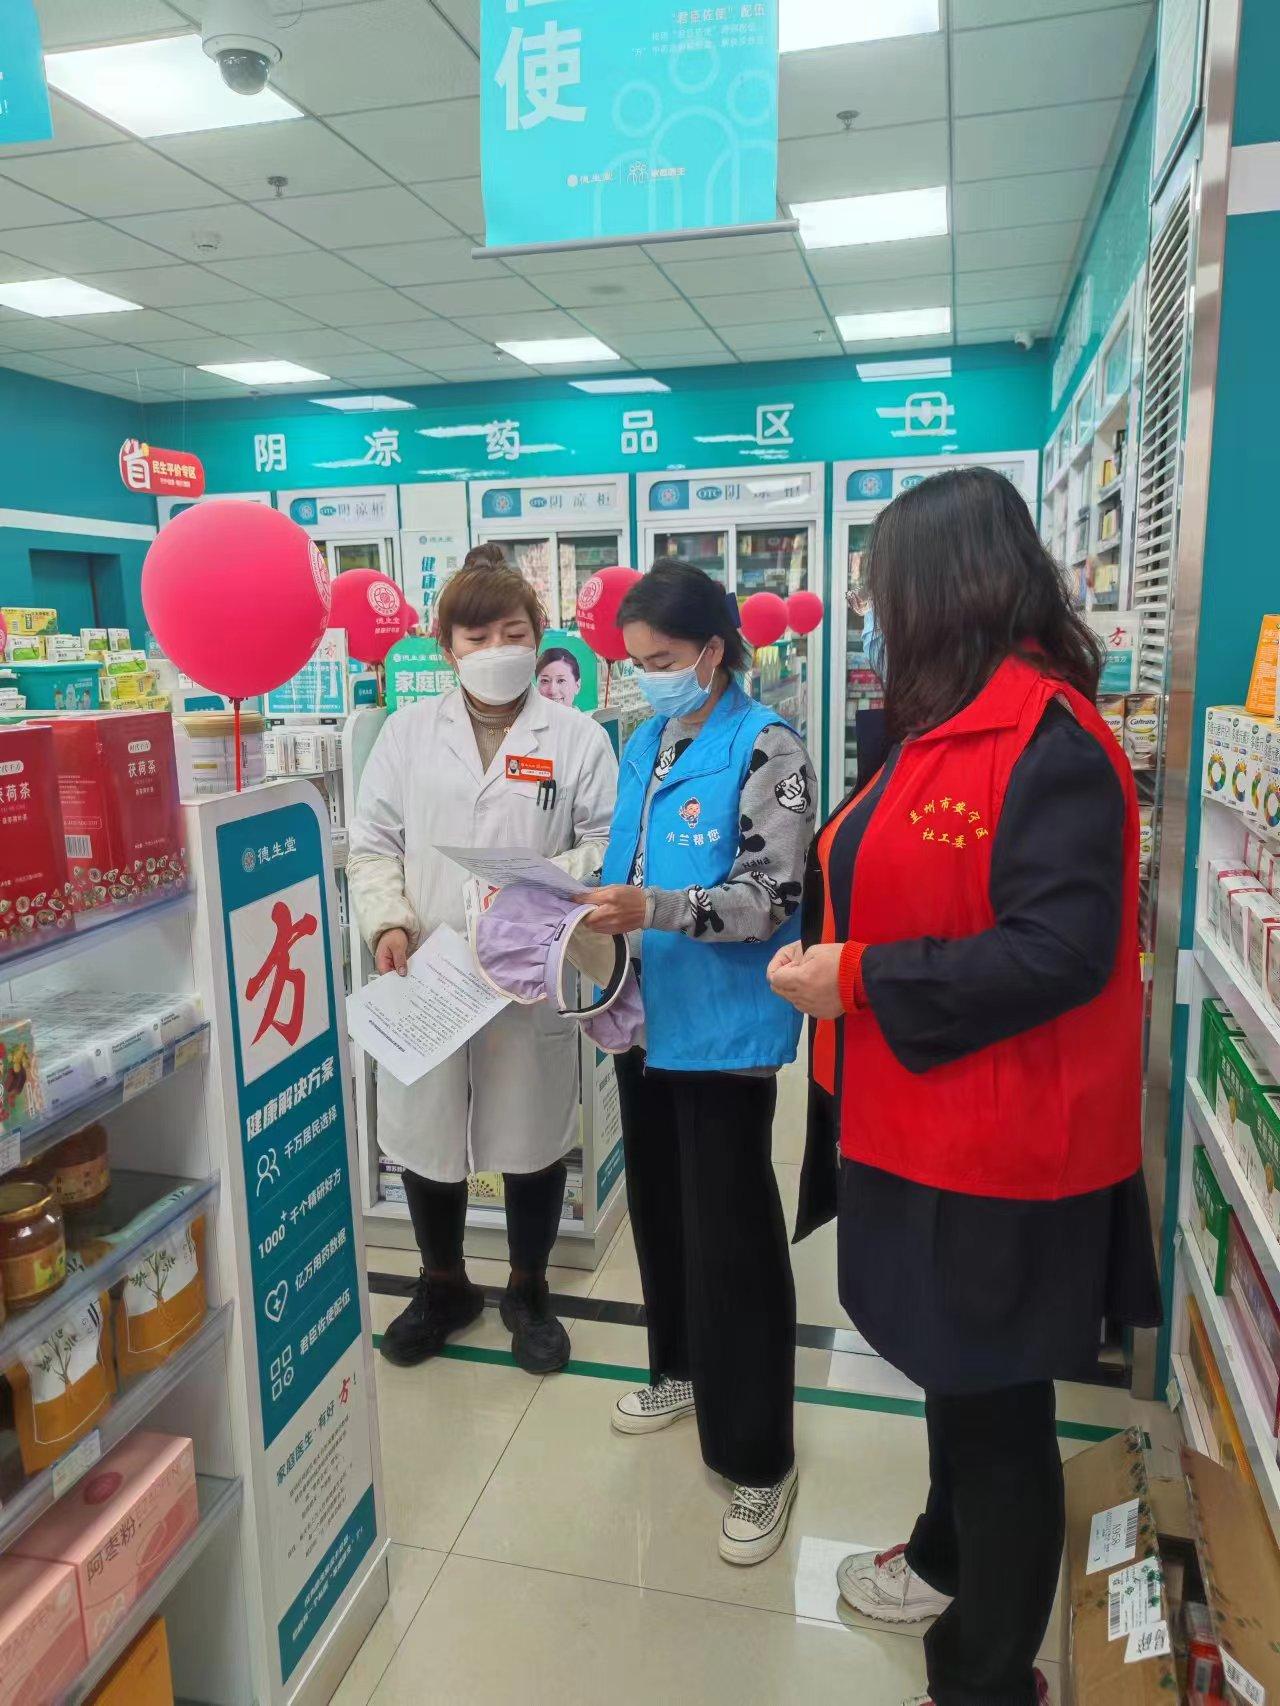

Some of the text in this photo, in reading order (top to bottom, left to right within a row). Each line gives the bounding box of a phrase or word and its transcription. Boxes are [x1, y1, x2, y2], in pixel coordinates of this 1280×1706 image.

[122, 438, 152, 490] 省
[253, 403, 795, 473] 阴凉药品区
[697, 486, 721, 499] OTC
[1108, 626, 1127, 647] 方
[1129, 718, 1156, 727] Caltrate
[257, 837, 297, 864] 德生堂
[665, 828, 721, 847] 小兰帮您
[245, 900, 318, 1047] 方
[246, 1055, 335, 1143] 健康解决方案
[284, 1104, 338, 1159] 千万居民选择
[294, 1227, 347, 1293] 亿万用药数据
[299, 1287, 351, 1357] 君臣佐使配伍
